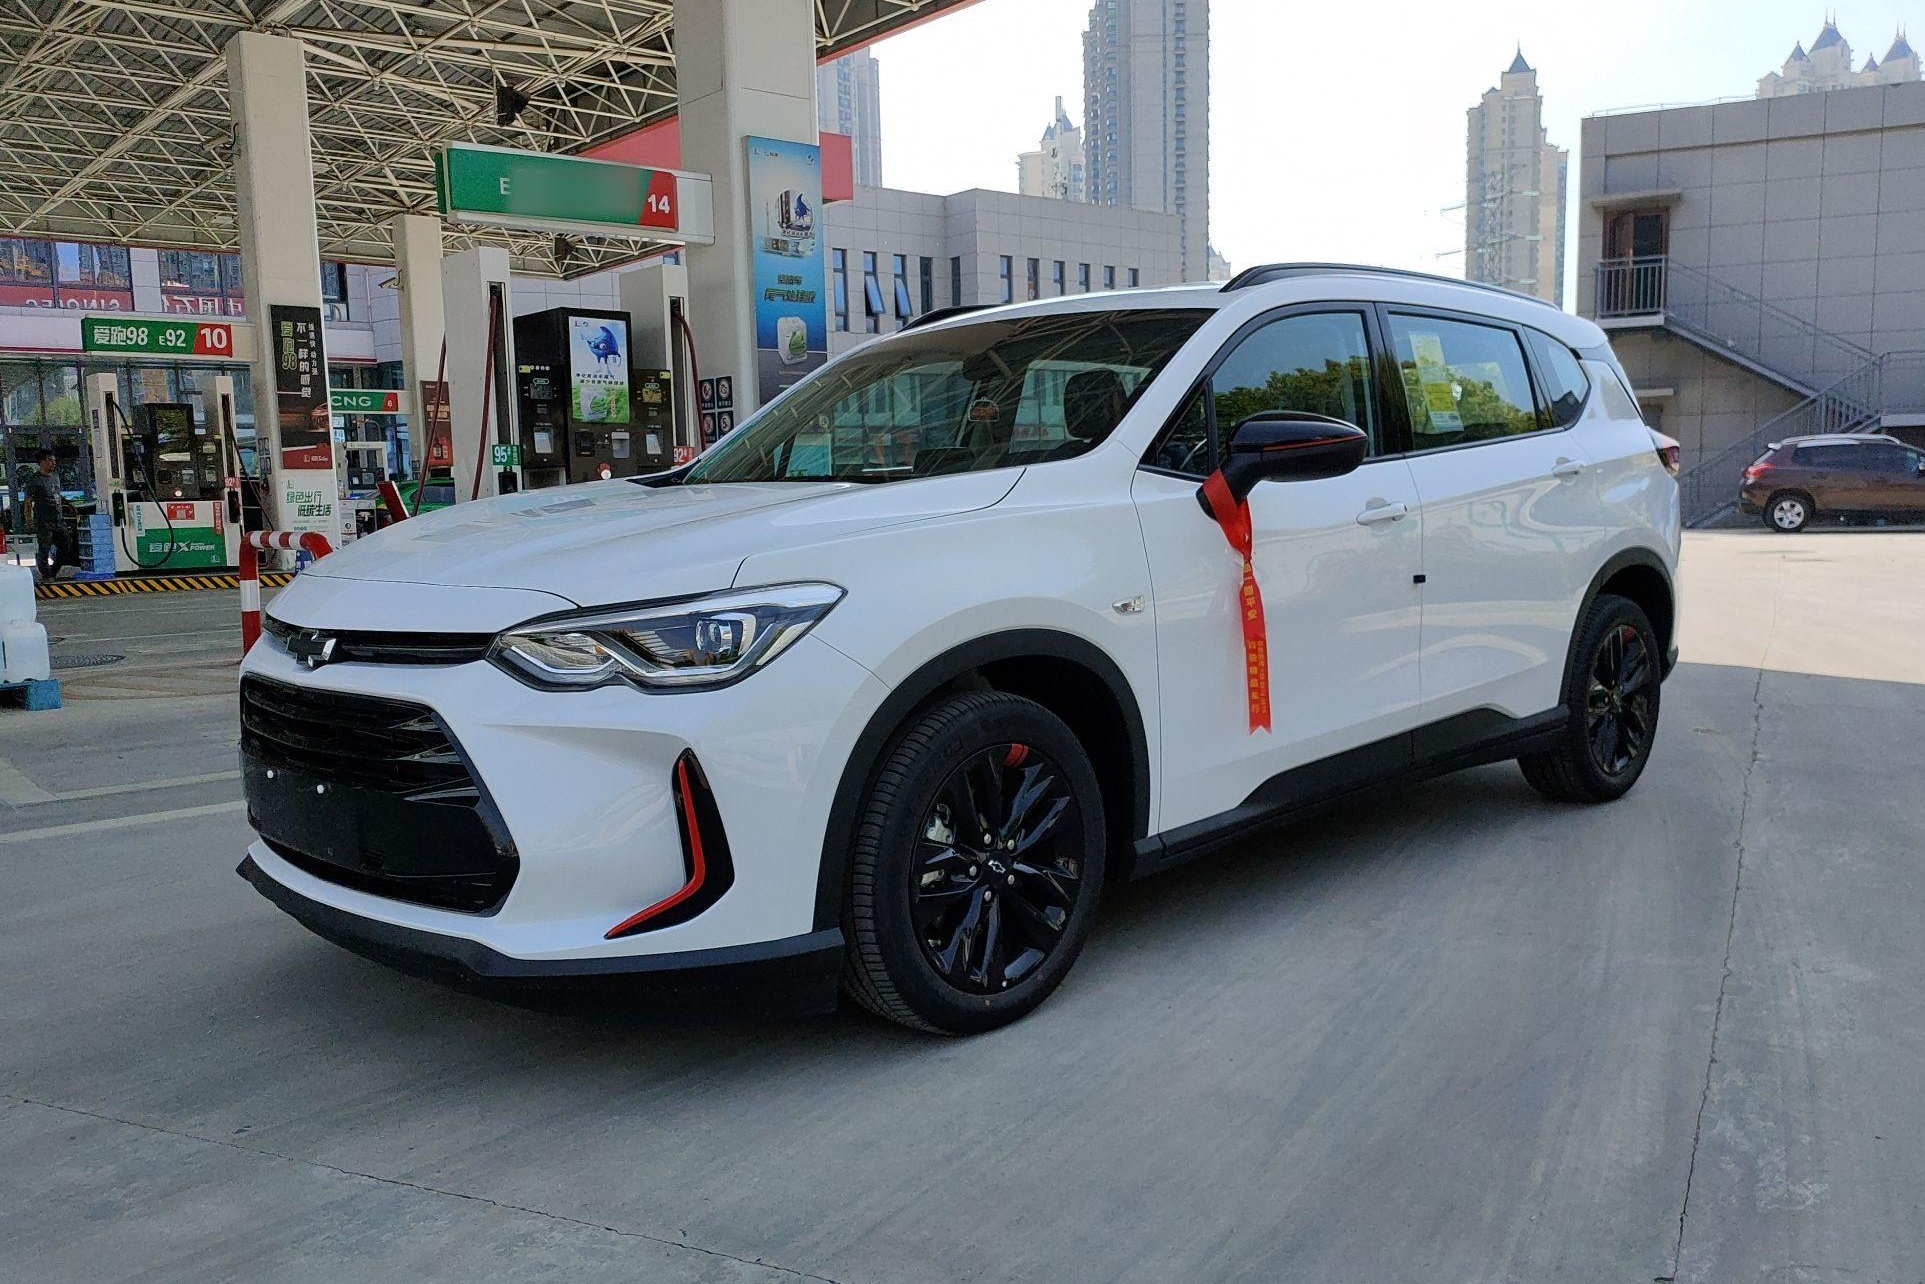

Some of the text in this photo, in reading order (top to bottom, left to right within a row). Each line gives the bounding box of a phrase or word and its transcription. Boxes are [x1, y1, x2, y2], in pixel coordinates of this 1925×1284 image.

[647, 194, 671, 214] 14
[158, 328, 187, 347] E92
[200, 327, 228, 349] 10
[331, 396, 372, 407] CNG
[286, 491, 322, 503] 绿色出行
[298, 504, 332, 517] 低碳生活
